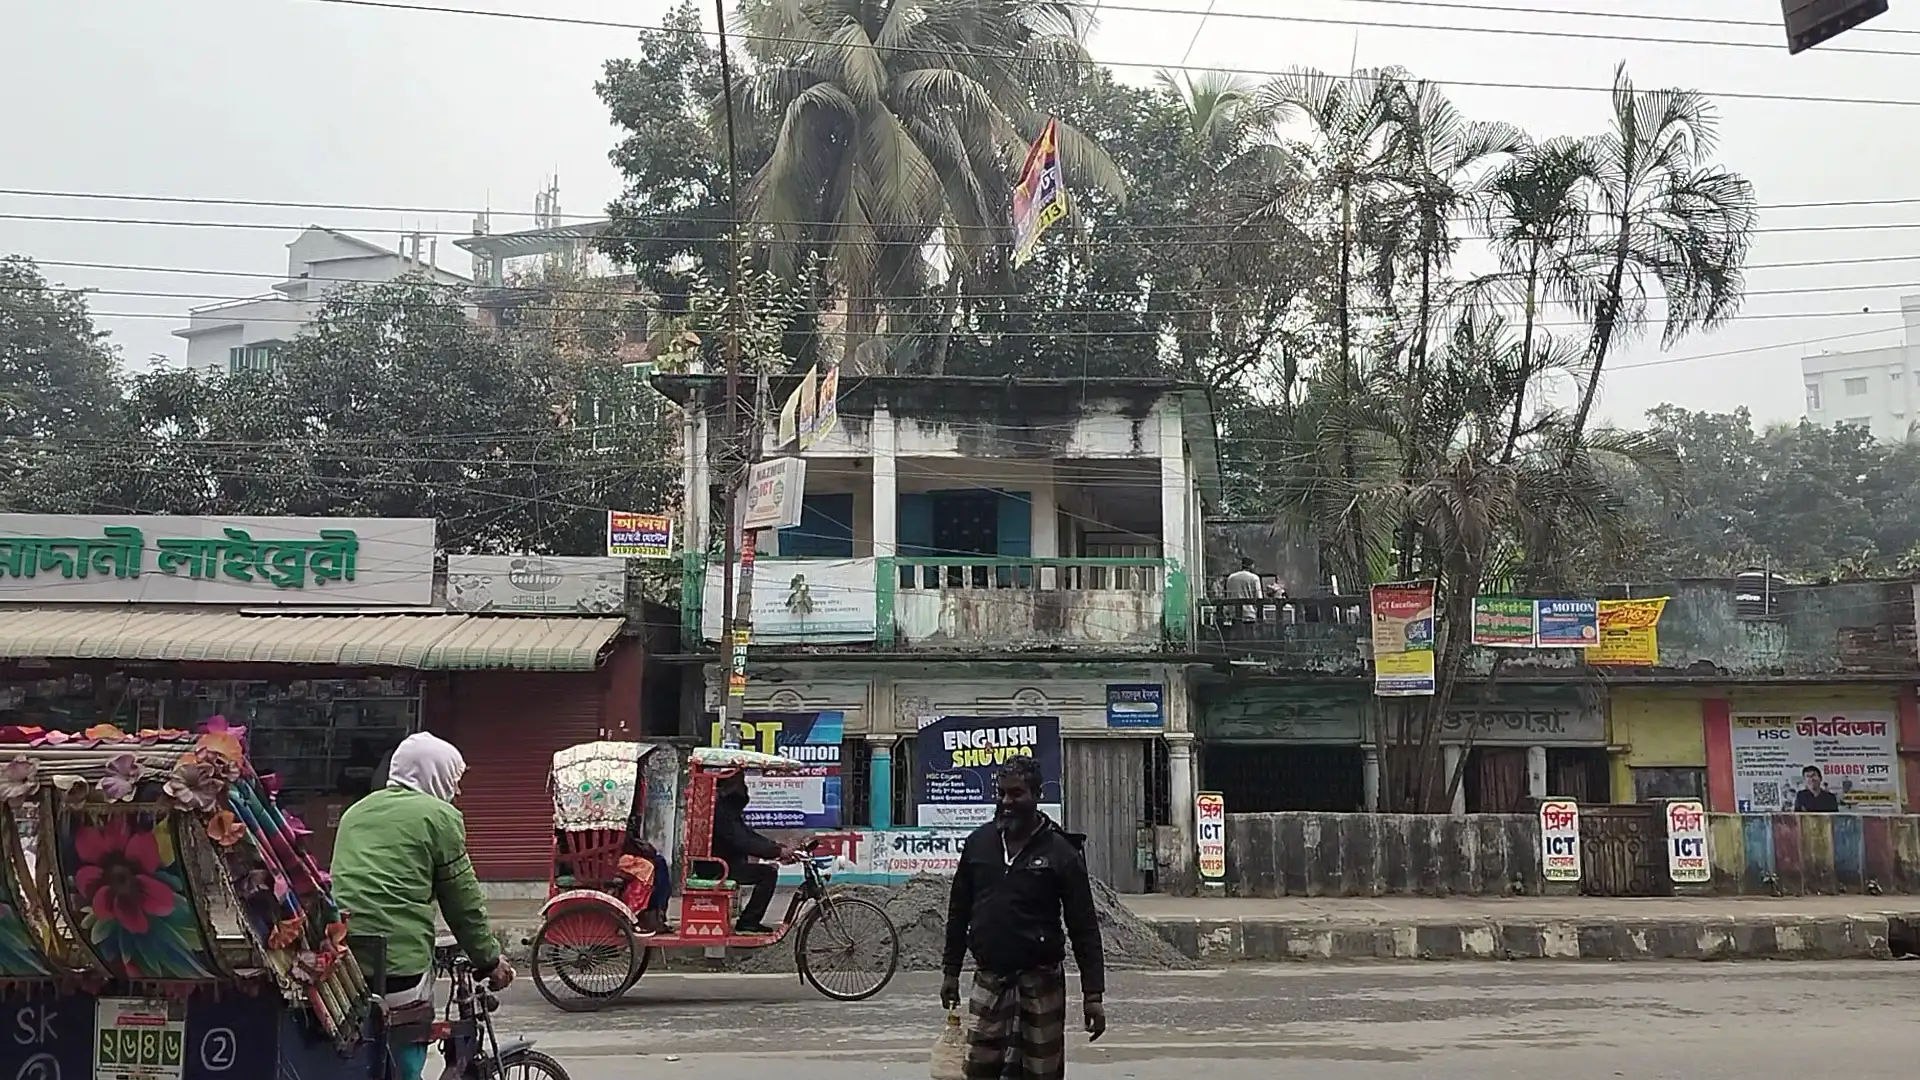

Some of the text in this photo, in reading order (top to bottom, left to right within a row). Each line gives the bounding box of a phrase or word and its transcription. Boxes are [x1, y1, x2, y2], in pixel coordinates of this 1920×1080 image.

[760, 481, 774, 497] ICT
[156, 527, 360, 589] লাইব্রেরী
[1552, 602, 1595, 612] MOTION
[1757, 729, 1791, 740] HSC
[1796, 716, 1886, 736] জীববিজ্ঞান
[943, 726, 1037, 750] ENGLISH
[778, 744, 840, 761] sumon
[1823, 764, 1866, 775] BIOLOGY
[1199, 823, 1222, 841] ICT
[1545, 836, 1576, 856] ICT
[1673, 838, 1704, 857] ICT
[102, 1033, 179, 1060] ২৬৪৬
